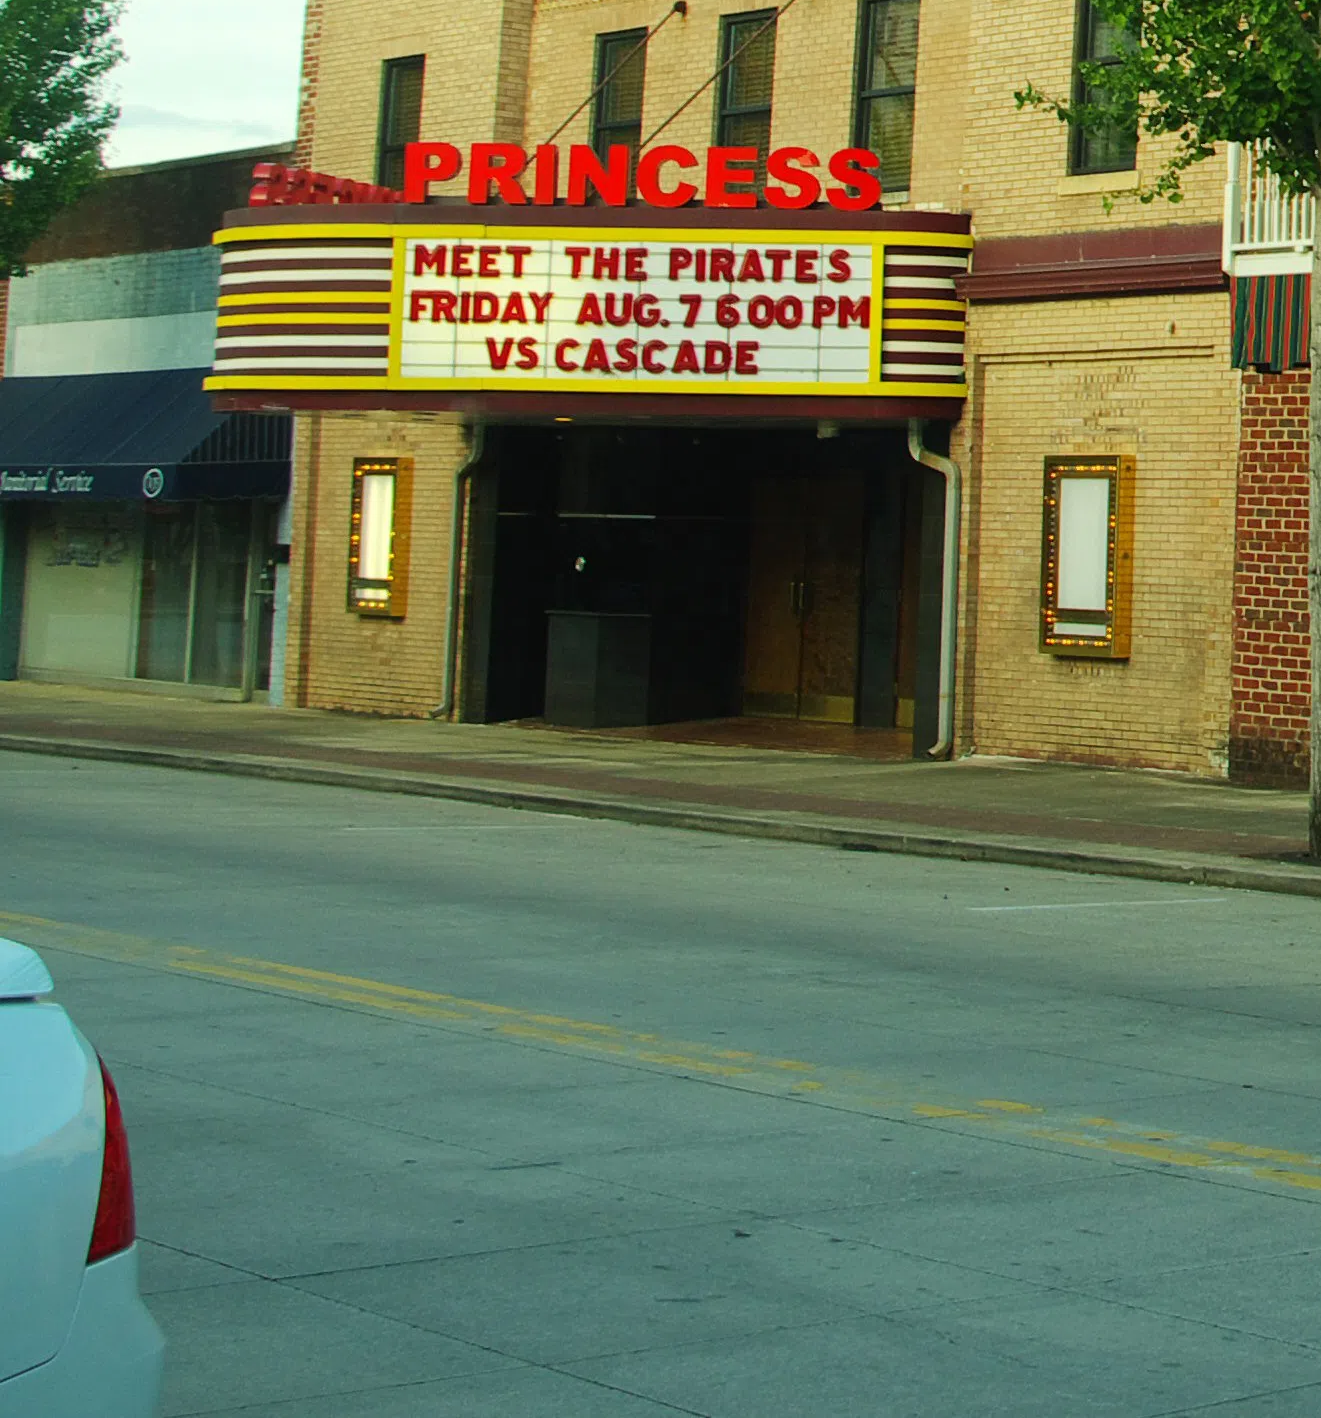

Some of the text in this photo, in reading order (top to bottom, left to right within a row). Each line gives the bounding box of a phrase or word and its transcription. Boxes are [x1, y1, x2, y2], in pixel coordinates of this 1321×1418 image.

[402, 142, 882, 211] PRINCESS
[414, 244, 852, 283] MEET THE PIRATES
[410, 289, 554, 324] FRIDAY
[576, 291, 671, 329] AUG.
[679, 294, 702, 328] 7
[812, 294, 872, 330] PM
[485, 337, 760, 376] VS CASCADE
